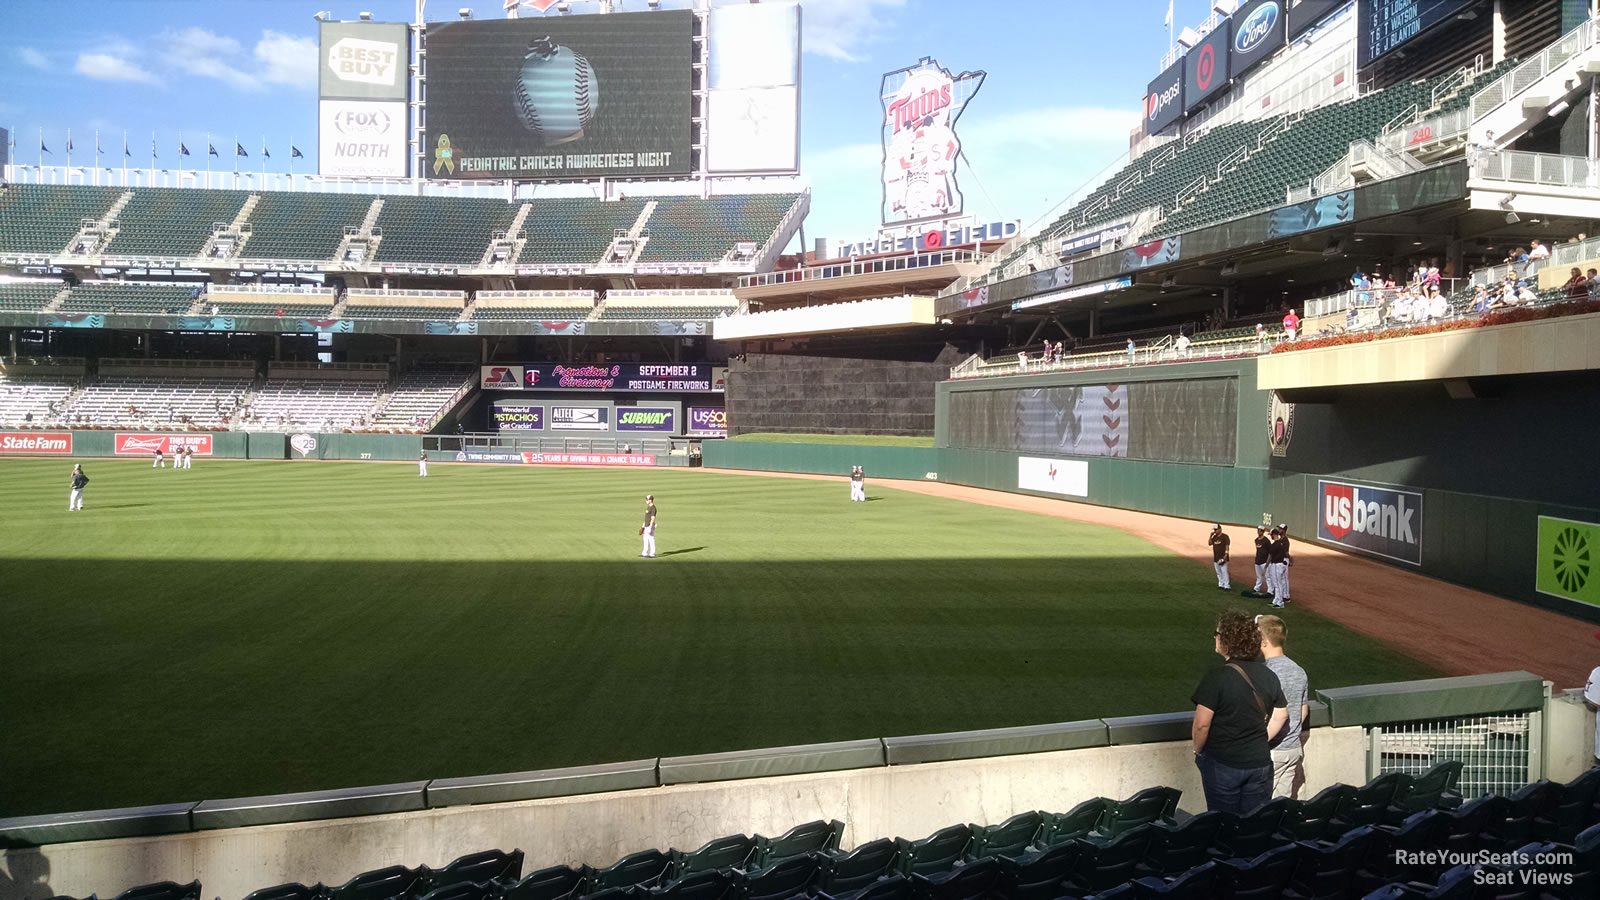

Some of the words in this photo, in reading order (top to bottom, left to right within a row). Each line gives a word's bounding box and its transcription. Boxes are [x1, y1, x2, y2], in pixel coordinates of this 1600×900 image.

[1391, 4, 1417, 30] WATSON
[1243, 10, 1270, 48] Ford
[1391, 18, 1420, 47] BLANTON
[339, 47, 395, 64] BEST
[340, 60, 389, 77] BUY
[1159, 78, 1180, 112] pepsi
[888, 84, 951, 135] Twins
[346, 111, 378, 126] FOX
[1413, 127, 1431, 138] 240
[335, 142, 390, 158] NORTH
[460, 156, 517, 171] PEDIATRIC
[520, 155, 563, 170] CANCER
[566, 153, 633, 168] AWARENESS
[637, 151, 671, 167] NIGHT
[838, 233, 921, 257] TARGET
[946, 219, 1021, 247] FIELD
[551, 365, 609, 377] Promotions
[640, 365, 688, 376] SEPTEMBER
[691, 366, 697, 376] 2
[559, 376, 614, 391] Giveaways
[629, 380, 665, 389] POSTGAME
[667, 380, 709, 390] FIREWORKS
[494, 414, 539, 422] PISTACHIOS
[553, 408, 573, 418] ALTEC
[619, 412, 672, 424] SUBWAY
[126, 440, 161, 448] Budweiser
[169, 437, 184, 445] THIS
[303, 440, 315, 449] 29
[532, 453, 544, 463] 25
[926, 472, 938, 480] 403
[1263, 512, 1272, 526] 365
